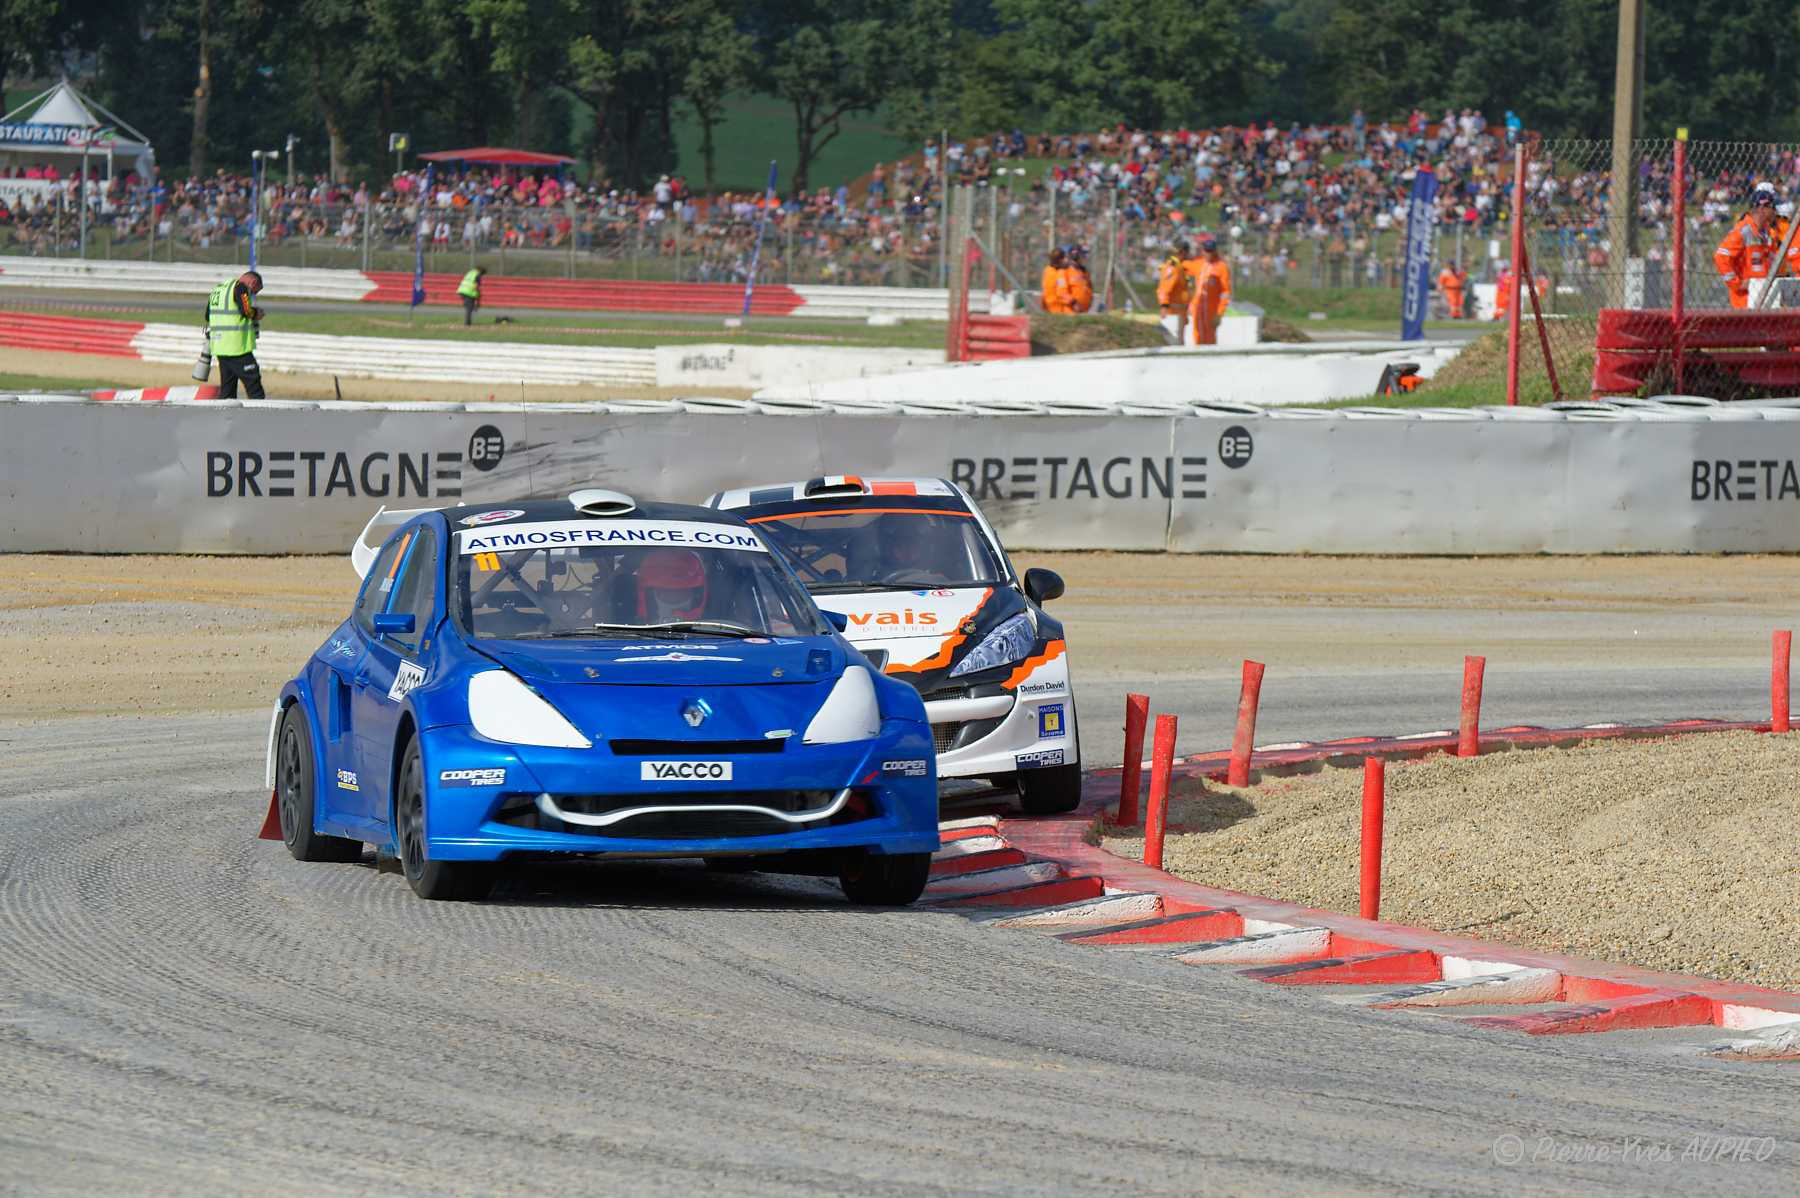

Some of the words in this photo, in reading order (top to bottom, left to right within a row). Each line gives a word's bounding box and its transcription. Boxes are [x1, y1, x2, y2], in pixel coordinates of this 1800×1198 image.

[207, 451, 463, 498] BRETAGNE
[951, 457, 1207, 500] BRETAGNE
[1691, 459, 1800, 501] BRETA
[467, 529, 759, 552] ATMOSFRANCE.COM
[848, 609, 938, 625] vais
[1046, 681, 1065, 690] David
[1017, 750, 1063, 763] COOPER
[1040, 758, 1063, 767] TIRES
[651, 763, 723, 778] YACCO
[882, 761, 926, 770] COOPER
[440, 769, 506, 780] COOPER
[471, 778, 505, 786] TIRES
